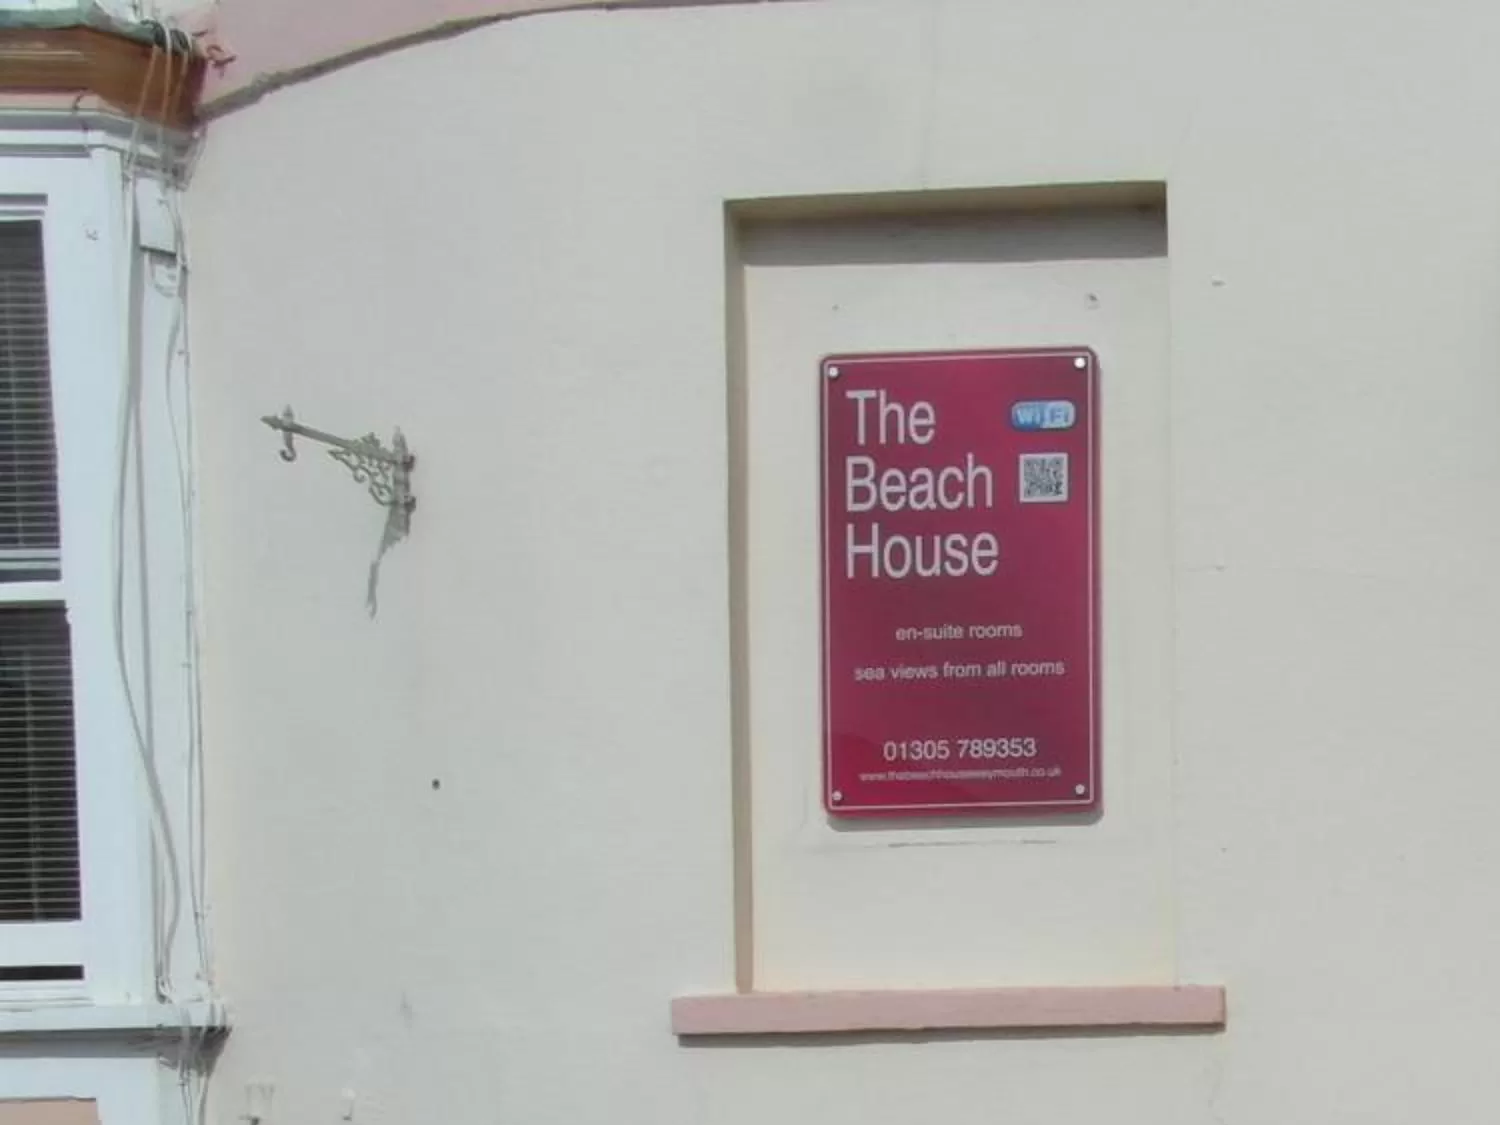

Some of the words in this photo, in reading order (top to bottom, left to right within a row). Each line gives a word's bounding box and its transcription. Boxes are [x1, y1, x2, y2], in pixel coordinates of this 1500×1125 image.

[846, 389, 936, 445] The
[846, 452, 993, 512] Beach
[847, 522, 999, 578] House
[896, 624, 964, 640] en-suite
[969, 624, 1023, 638] rooms
[855, 667, 885, 681] sea
[890, 663, 938, 680] views
[943, 660, 982, 678] from
[987, 660, 1006, 677] all
[1011, 659, 1065, 676] rooms
[883, 740, 950, 761] 01305
[957, 737, 1037, 758] 789353
